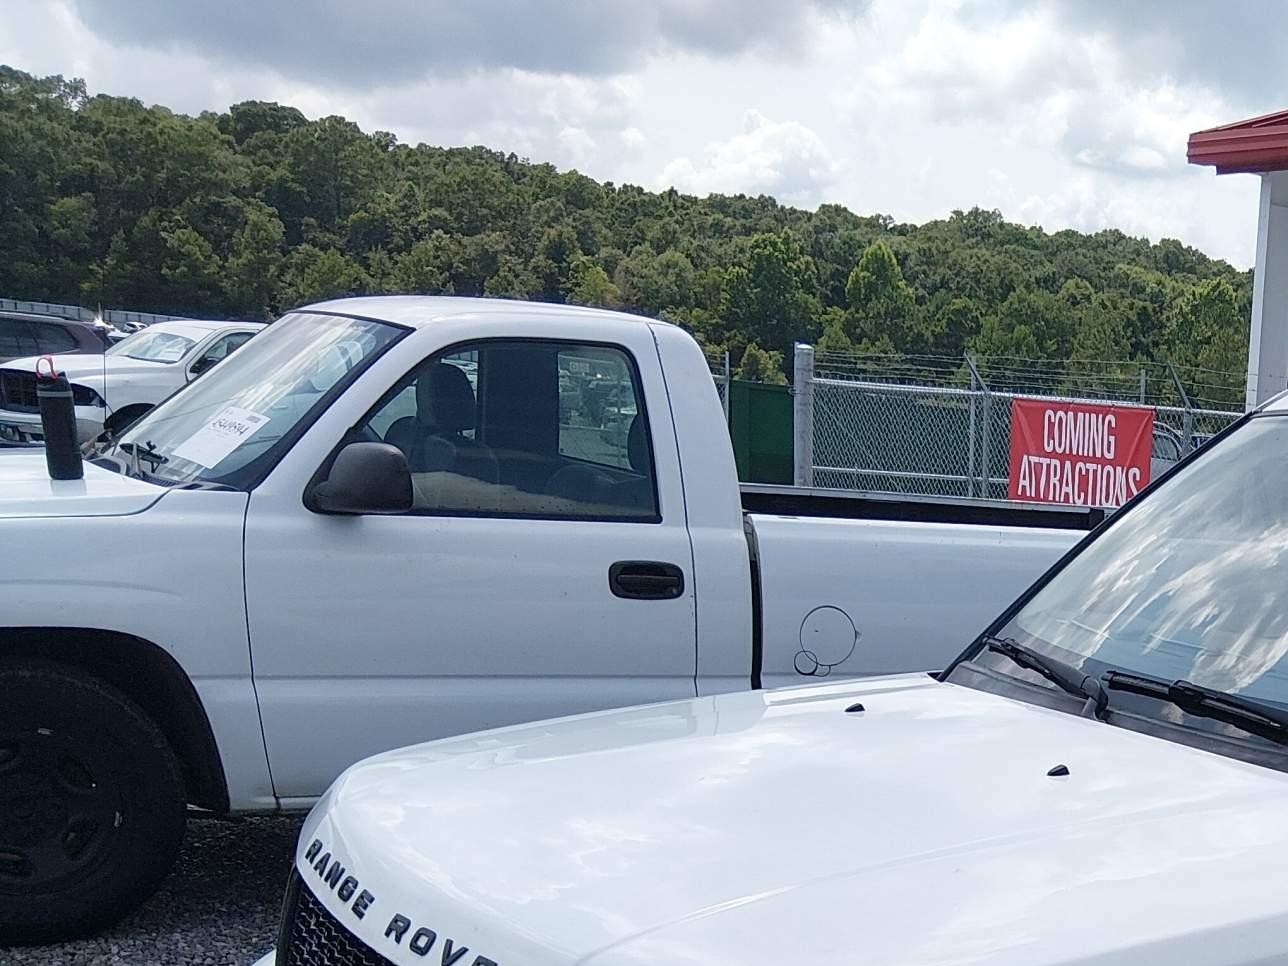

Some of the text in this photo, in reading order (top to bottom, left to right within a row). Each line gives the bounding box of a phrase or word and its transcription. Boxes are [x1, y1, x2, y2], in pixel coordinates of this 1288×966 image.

[1043, 409, 1116, 460] COMING
[1017, 454, 1141, 507] ATTRACTIONS
[304, 838, 375, 920] RANGE
